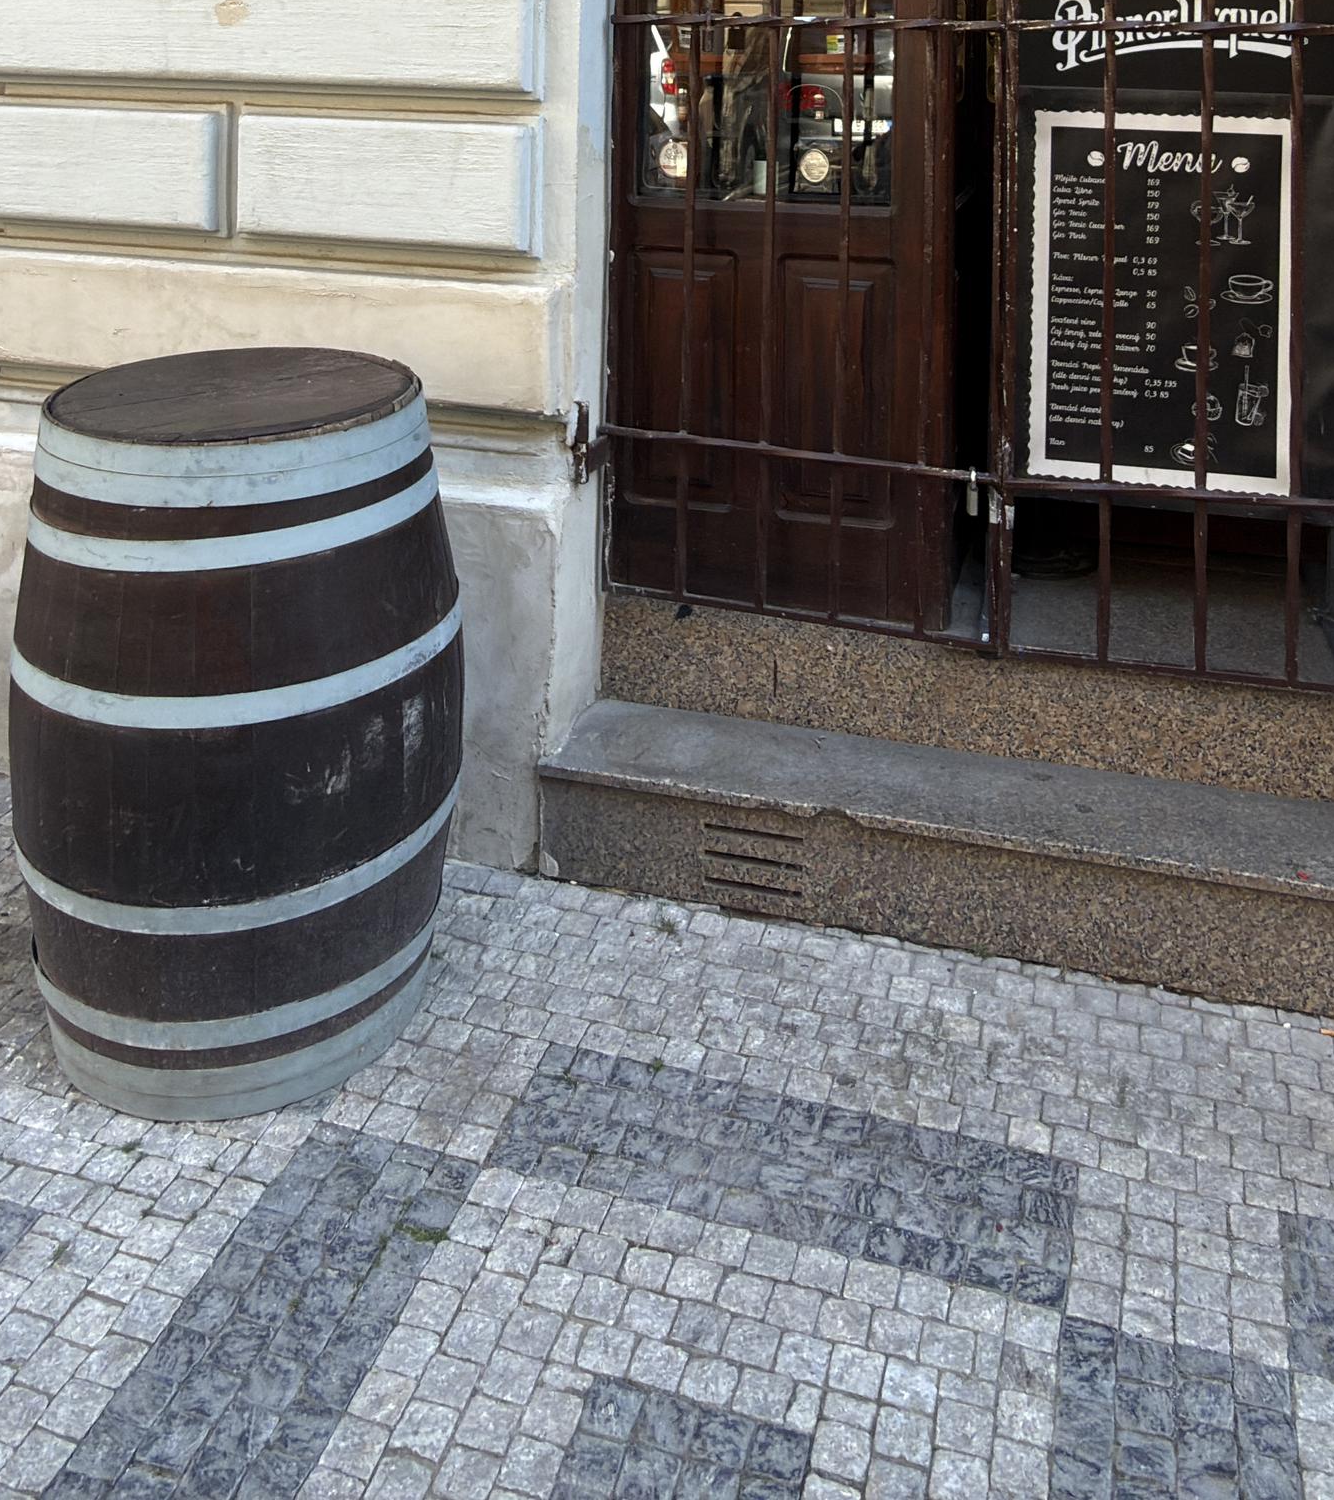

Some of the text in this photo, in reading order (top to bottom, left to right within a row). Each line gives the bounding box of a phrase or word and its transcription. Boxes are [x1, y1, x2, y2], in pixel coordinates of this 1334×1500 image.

[1147, 178, 1160, 186] 169
[1052, 185, 1072, 194] Cuba
[1074, 186, 1093, 195] Libre
[1052, 197, 1076, 206] Aperol
[1052, 208, 1066, 217] Gin
[1068, 209, 1087, 217] Tonic
[1052, 220, 1066, 229] Gin
[1068, 220, 1086, 229] Tonic
[1146, 224, 1160, 232] 169
[1052, 230, 1065, 240] Gin
[1146, 236, 1160, 244] 169
[1147, 257, 1158, 265] 69
[1146, 290, 1157, 298] 50
